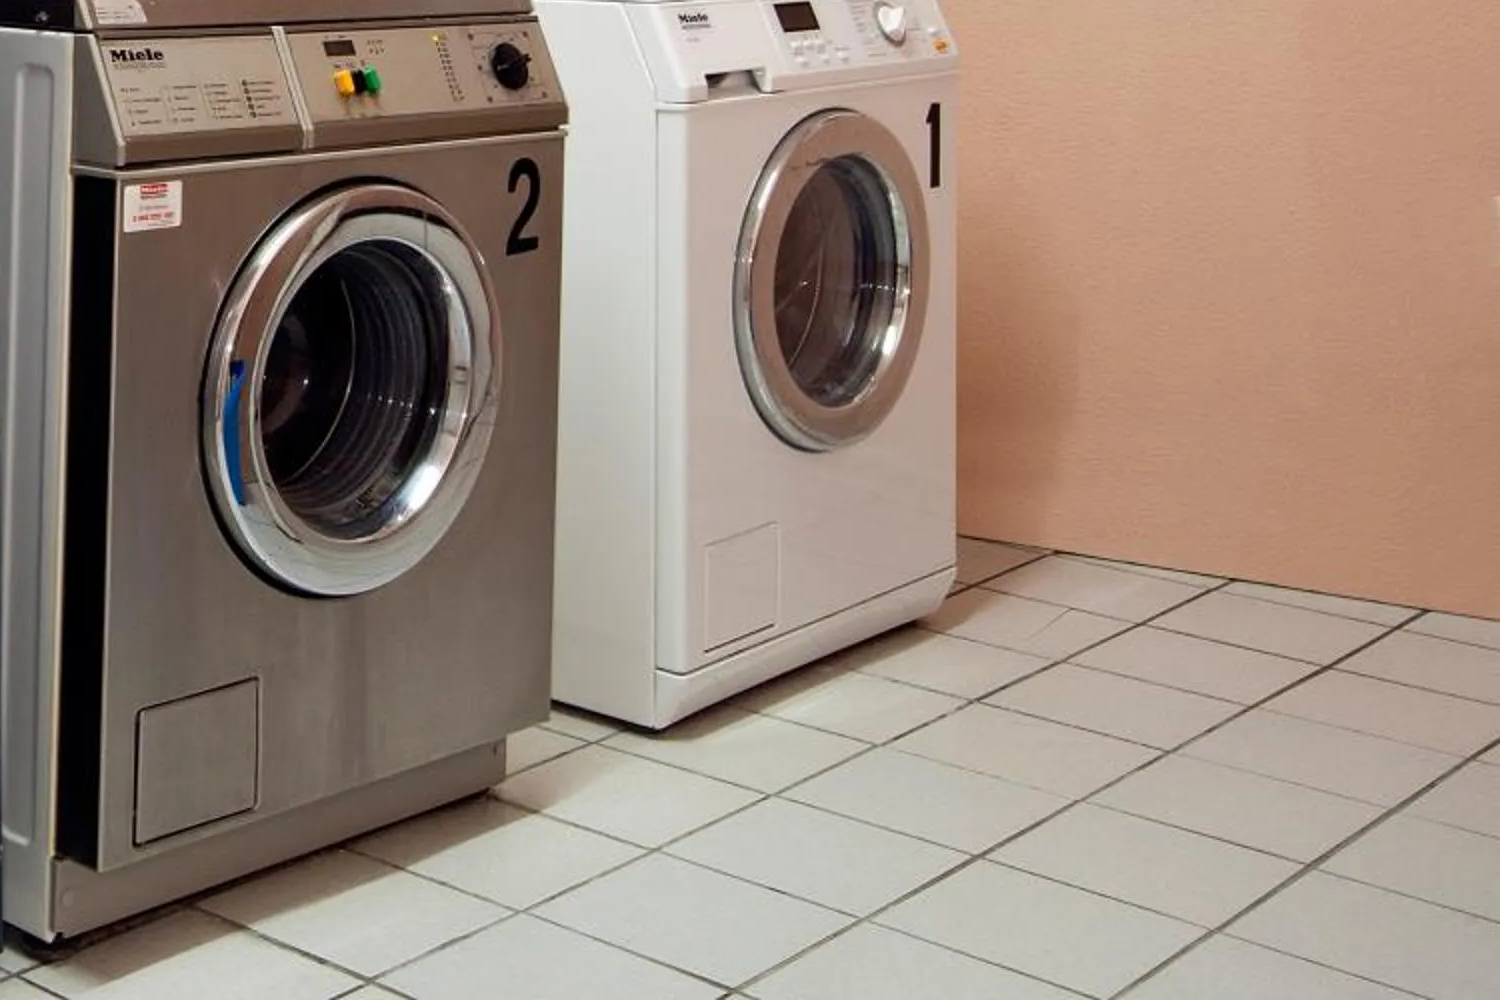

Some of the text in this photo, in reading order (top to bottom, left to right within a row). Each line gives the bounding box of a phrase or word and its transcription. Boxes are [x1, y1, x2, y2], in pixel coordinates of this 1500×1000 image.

[110, 48, 165, 62] Miele
[925, 102, 941, 189] 1
[506, 158, 541, 256] 2
